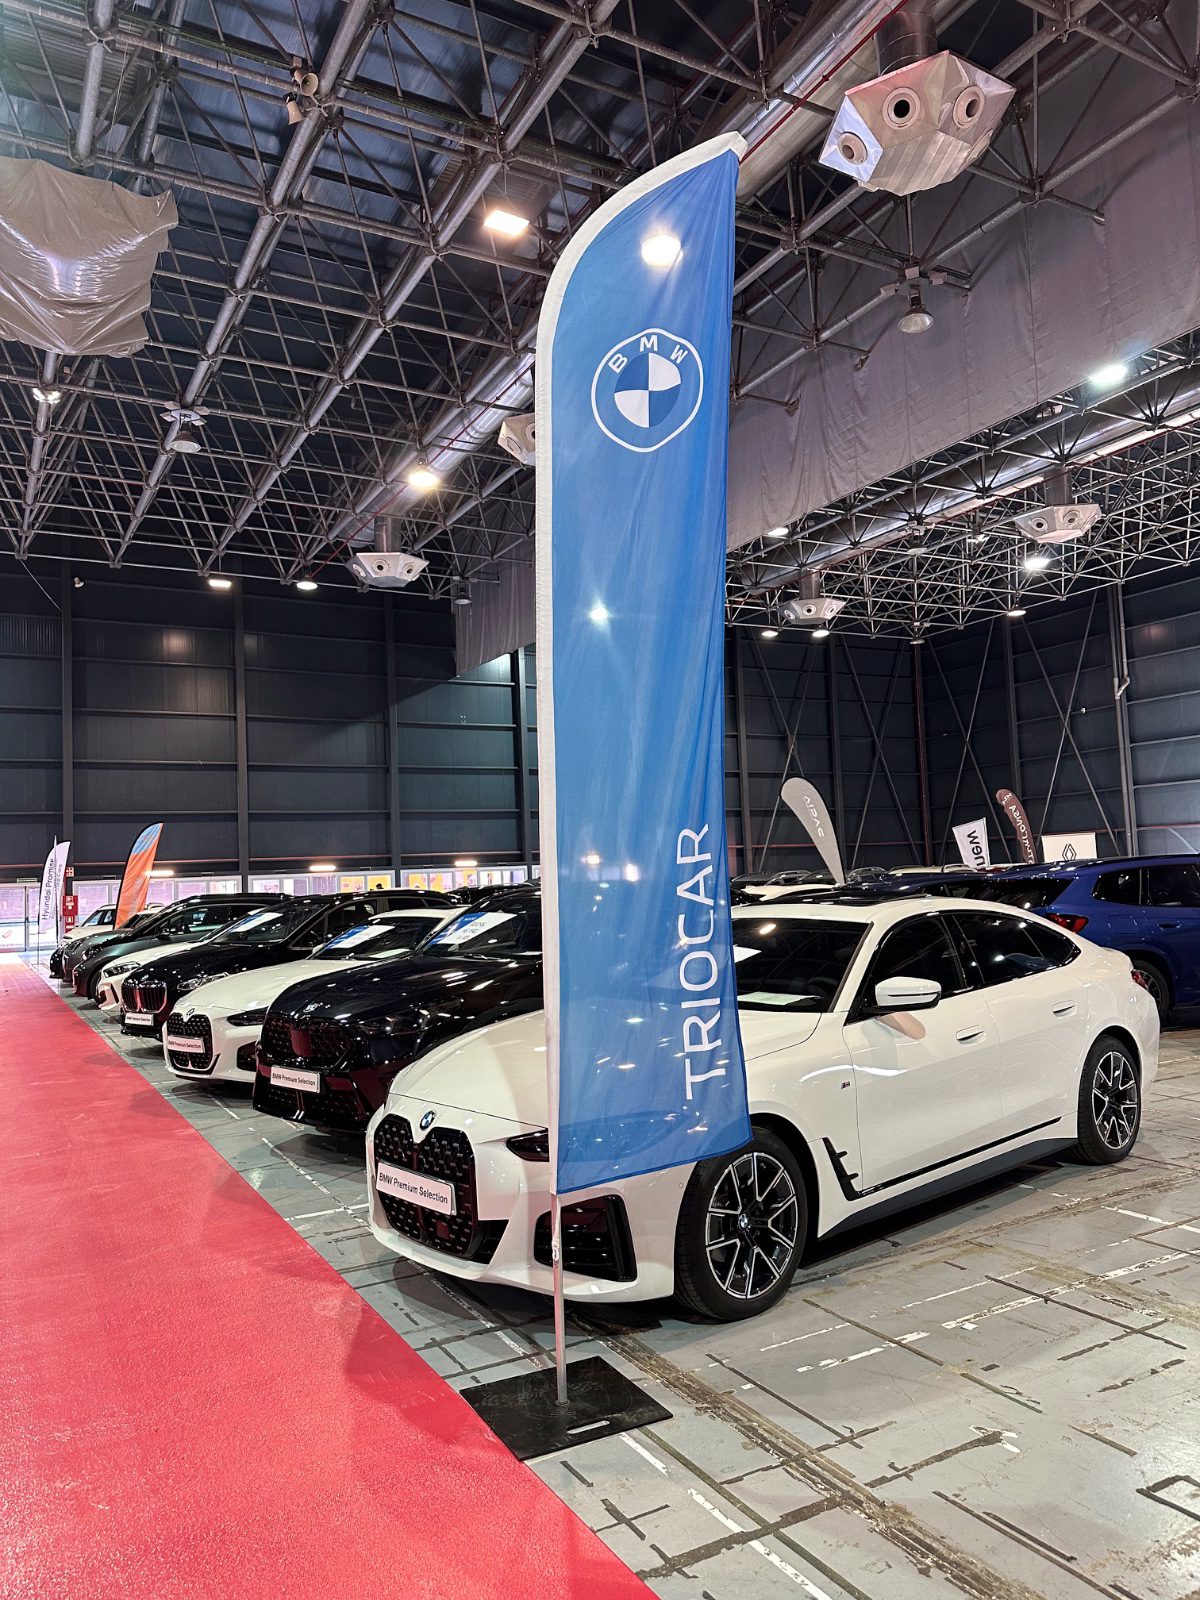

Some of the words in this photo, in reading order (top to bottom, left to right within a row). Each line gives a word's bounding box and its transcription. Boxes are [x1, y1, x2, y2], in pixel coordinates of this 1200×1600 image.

[607, 334, 688, 374] BMW
[41, 889, 52, 920] Hyundai
[676, 823, 726, 1100] TRIOCAR
[272, 1072, 281, 1080] BMW
[282, 1074, 298, 1083] Premium
[298, 1077, 316, 1086] Selection
[379, 1172, 393, 1185] BMW
[394, 1177, 419, 1194] Premium
[419, 1186, 448, 1204] Selection
